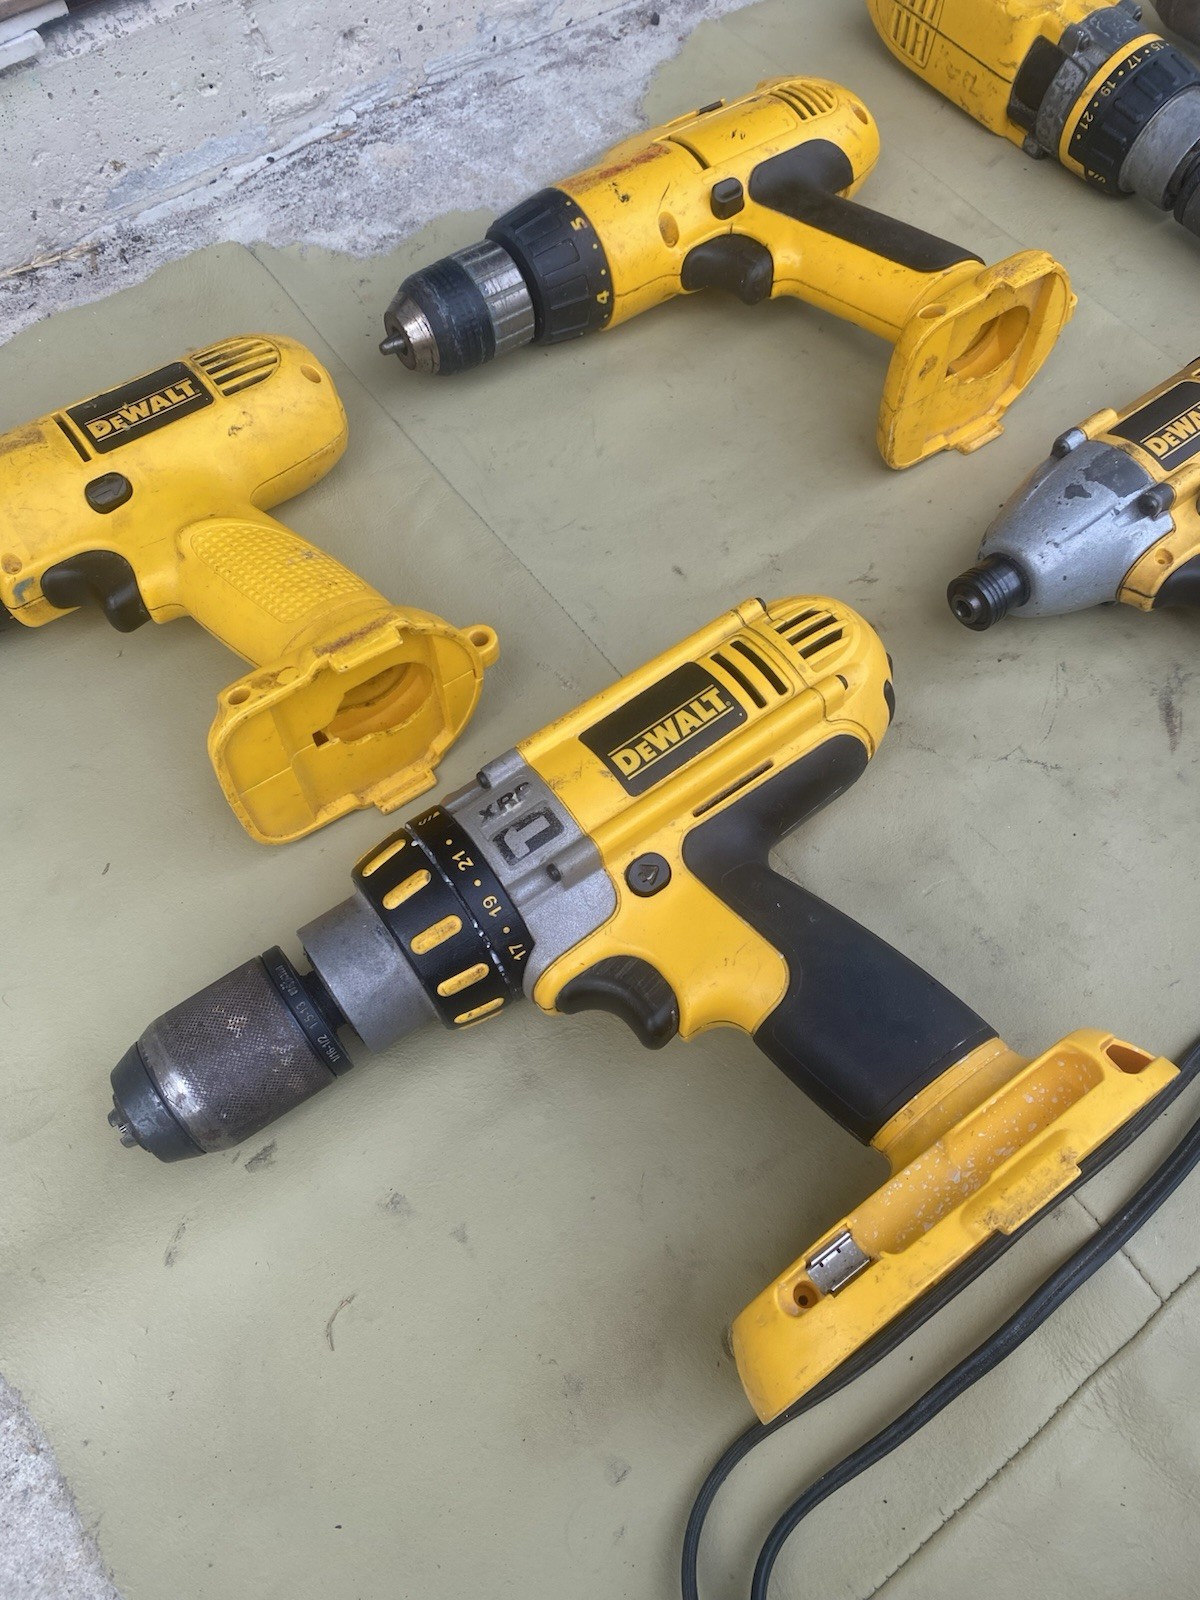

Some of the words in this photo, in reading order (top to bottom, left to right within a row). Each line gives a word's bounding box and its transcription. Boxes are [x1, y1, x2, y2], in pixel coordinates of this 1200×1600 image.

[1127, 54, 1142, 70] 17
[1100, 80, 1117, 97] 19
[1079, 111, 1094, 130] 21
[570, 216, 588, 231] 5
[596, 290, 610, 305] 4
[451, 850, 475, 871] 21
[482, 895, 503, 918] 19
[508, 943, 527, 961] 17
